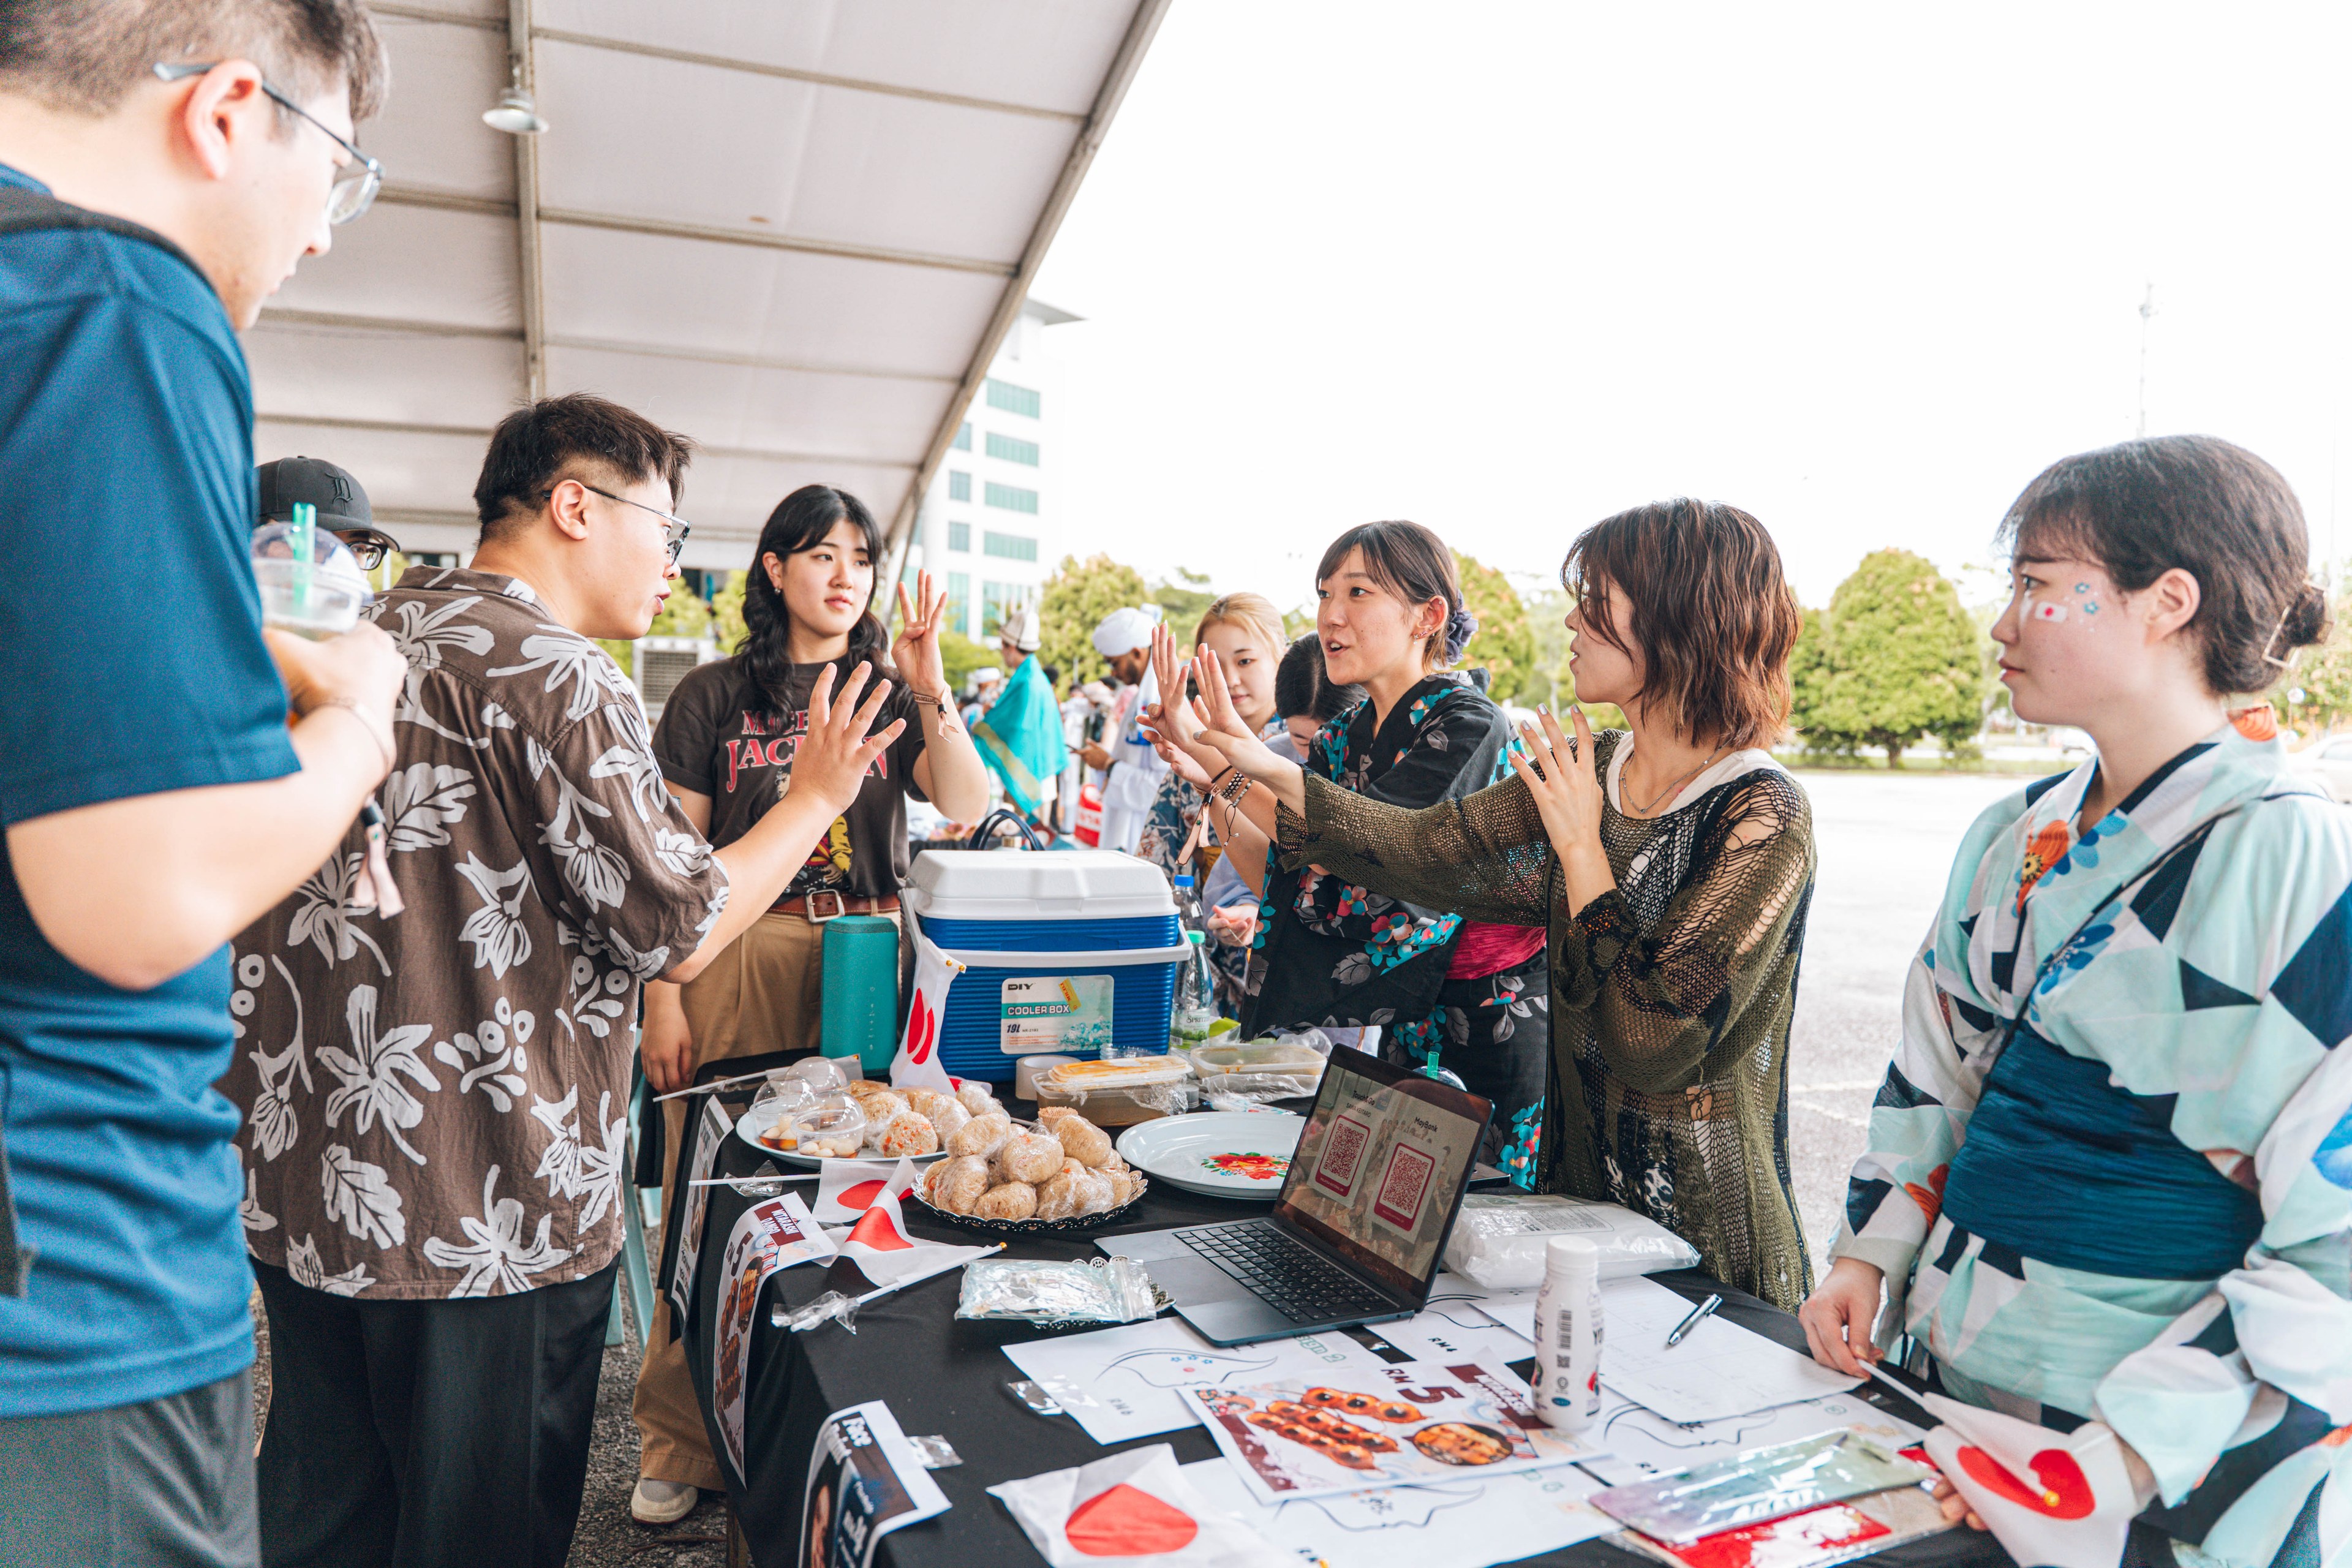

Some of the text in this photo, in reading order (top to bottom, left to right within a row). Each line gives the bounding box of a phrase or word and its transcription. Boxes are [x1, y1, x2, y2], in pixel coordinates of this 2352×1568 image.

[1007, 1005, 1071, 1016] COOLER BOX
[1006, 1023, 1020, 1033] 19L
[1414, 1117, 1438, 1133] MayBank
[760, 1217, 782, 1235] DANGO
[731, 1231, 754, 1277] 5
[1293, 1334, 1328, 1354] sign
[1380, 1368, 1465, 1404] RM 5
